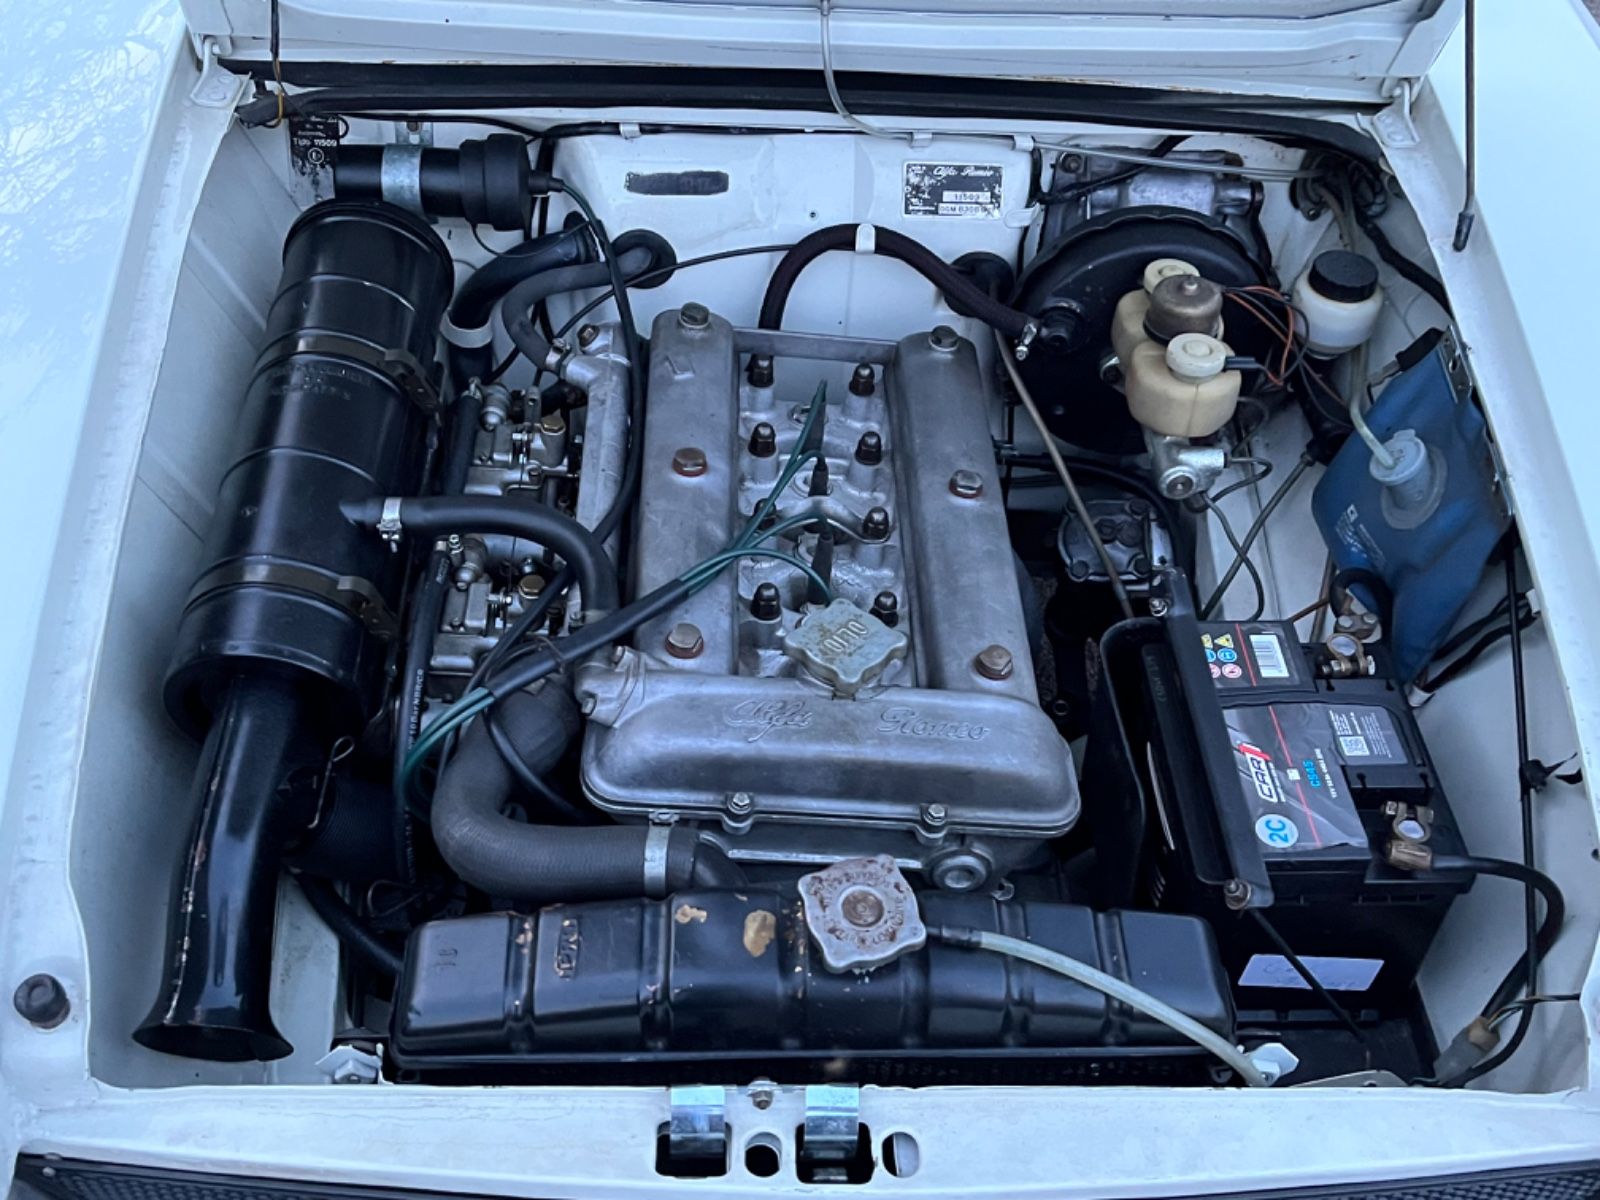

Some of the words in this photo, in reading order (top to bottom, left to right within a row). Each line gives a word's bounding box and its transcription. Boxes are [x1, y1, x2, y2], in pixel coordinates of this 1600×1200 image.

[724, 699, 813, 743] Alfa
[878, 707, 990, 741] Romeo
[1265, 819, 1289, 843] 2C
